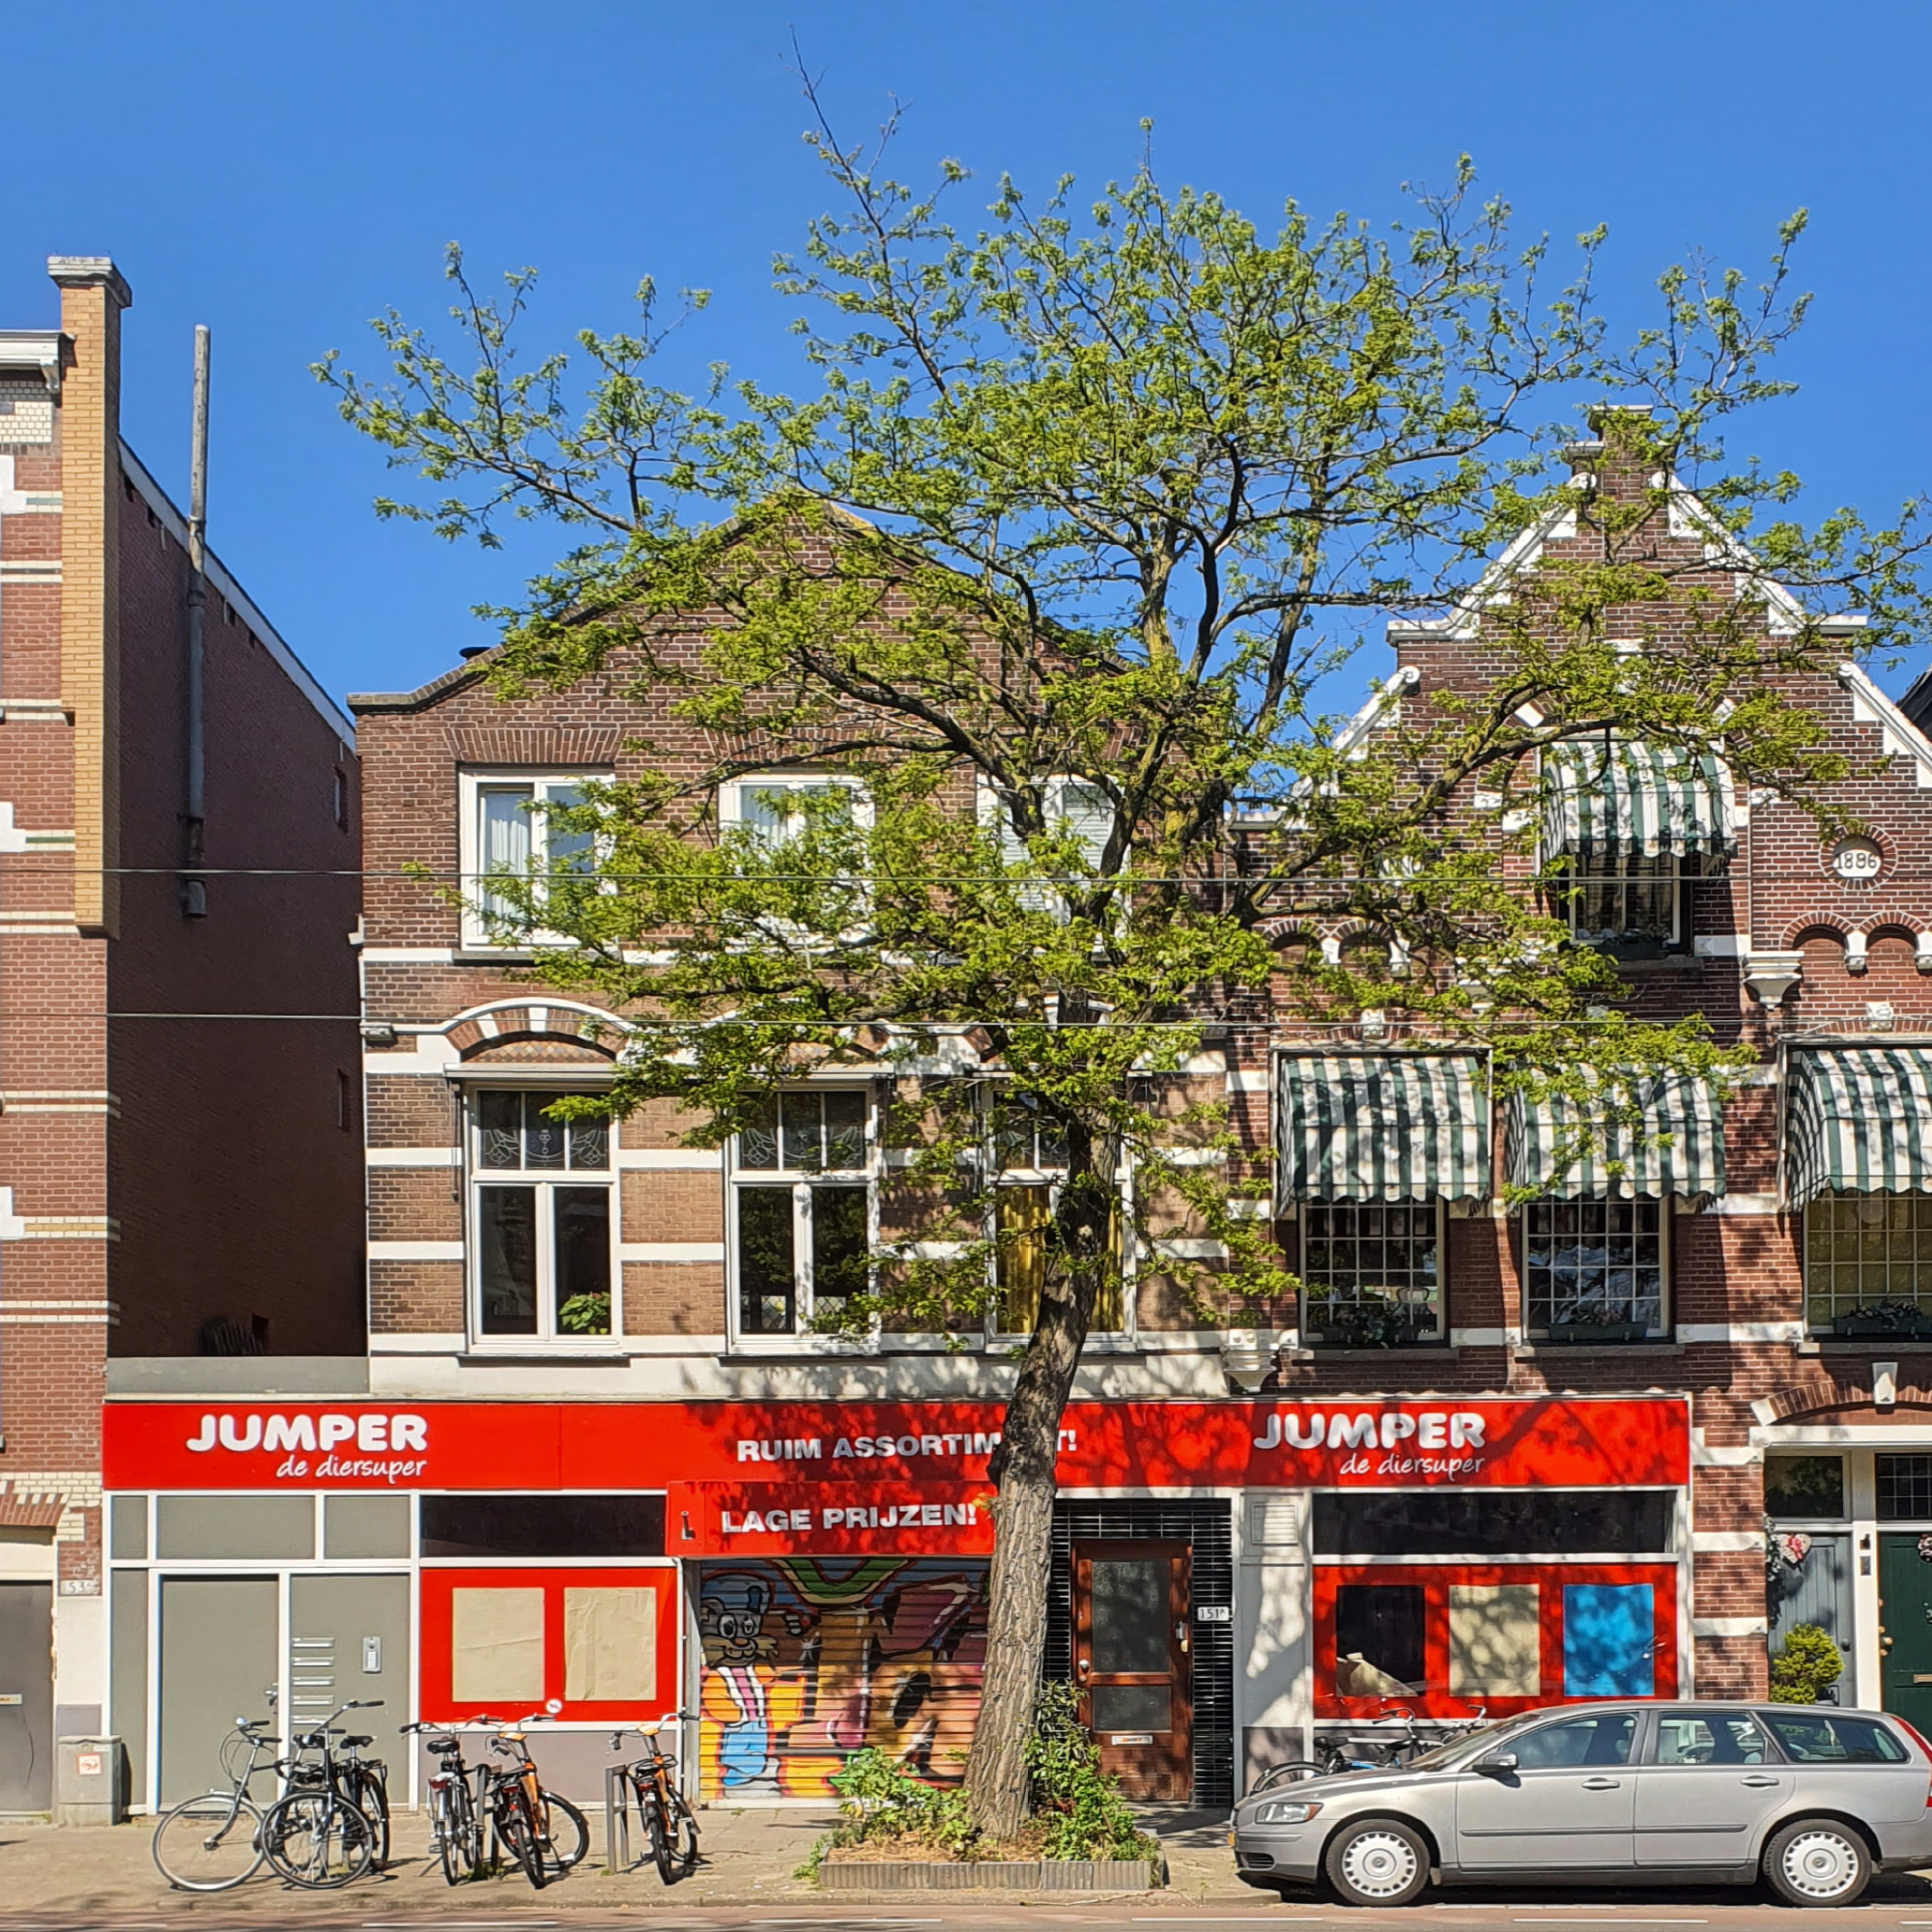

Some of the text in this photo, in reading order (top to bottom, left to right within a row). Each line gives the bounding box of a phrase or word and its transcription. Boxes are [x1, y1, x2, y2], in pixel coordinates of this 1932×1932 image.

[1835, 852, 1877, 869] 1886
[185, 1413, 428, 1452] JUMPER
[737, 1429, 1077, 1462] RUIM ASSORTIMT!
[1253, 1412, 1486, 1449] JUMPER
[275, 1454, 427, 1484] de diersuper
[1339, 1453, 1485, 1481] de diersuper
[721, 1503, 977, 1533] LAGE PRIJZEN!
